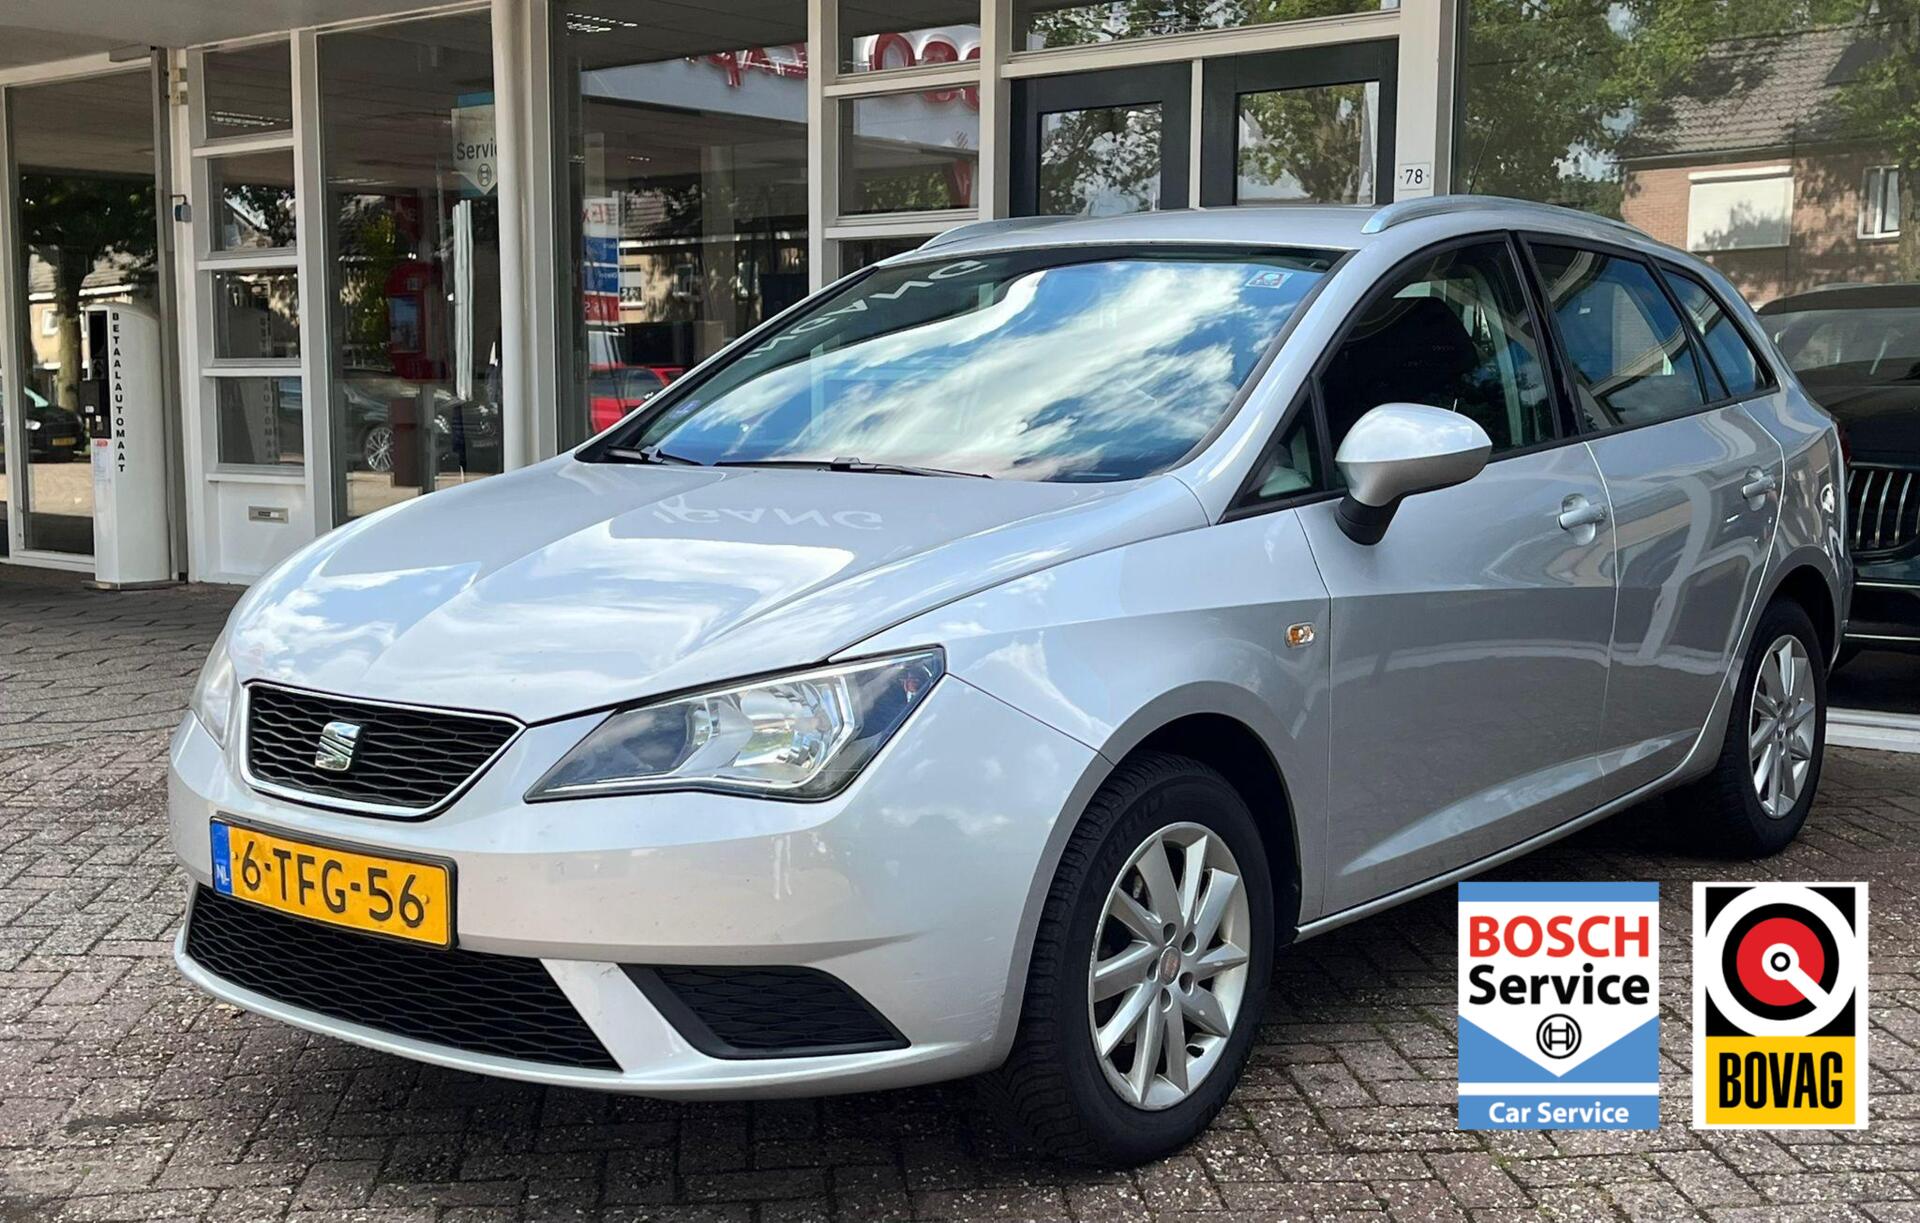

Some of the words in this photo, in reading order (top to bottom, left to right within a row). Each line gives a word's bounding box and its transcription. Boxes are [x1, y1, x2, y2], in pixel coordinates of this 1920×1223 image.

[1405, 168, 1423, 185] 78
[112, 312, 126, 473] BETAALAUTOMAAT
[215, 863, 230, 886] NL
[241, 840, 425, 929] 6-TFG-56
